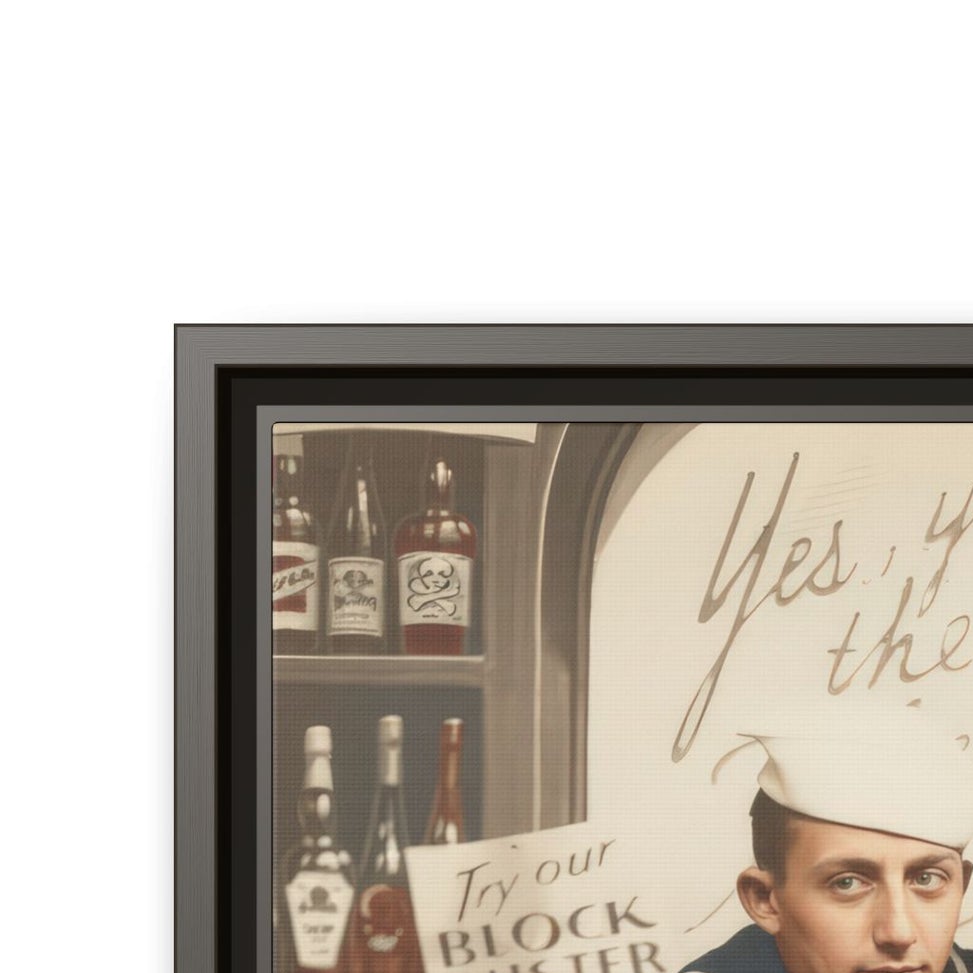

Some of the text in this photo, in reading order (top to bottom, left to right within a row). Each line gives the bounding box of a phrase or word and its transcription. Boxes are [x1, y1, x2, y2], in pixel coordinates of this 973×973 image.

[827, 576, 973, 695] the
[456, 838, 617, 923] Try our
[437, 895, 658, 969] BLOCK
